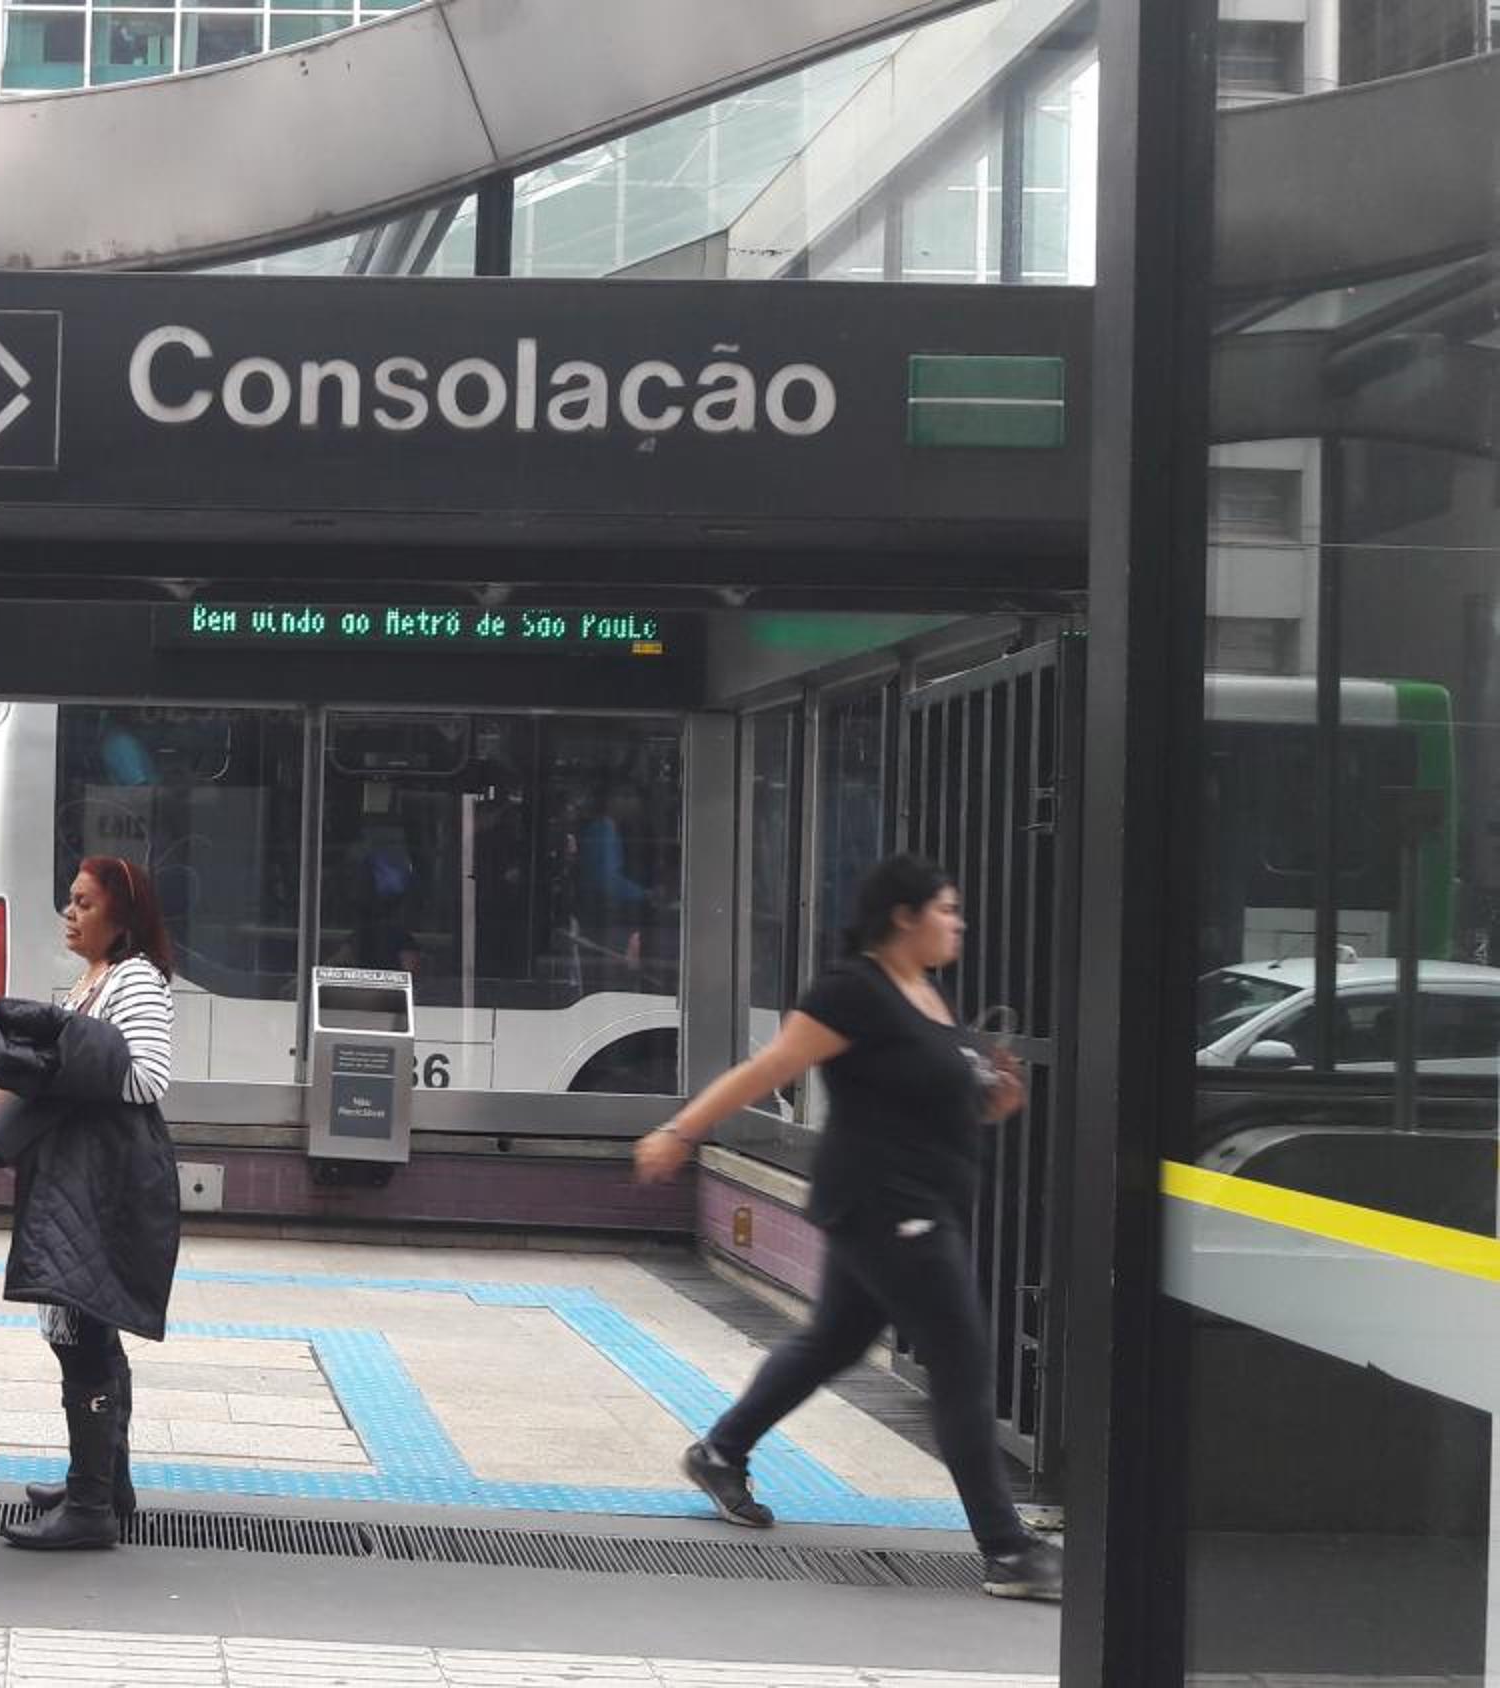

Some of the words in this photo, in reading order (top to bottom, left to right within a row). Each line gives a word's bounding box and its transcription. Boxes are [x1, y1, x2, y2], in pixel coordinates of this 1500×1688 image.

[129, 325, 837, 453] Consolação
[193, 605, 236, 632] Bem
[252, 608, 325, 633] vindo
[341, 613, 370, 635] ao
[476, 611, 506, 636] de
[413, 1053, 450, 1088] 6
